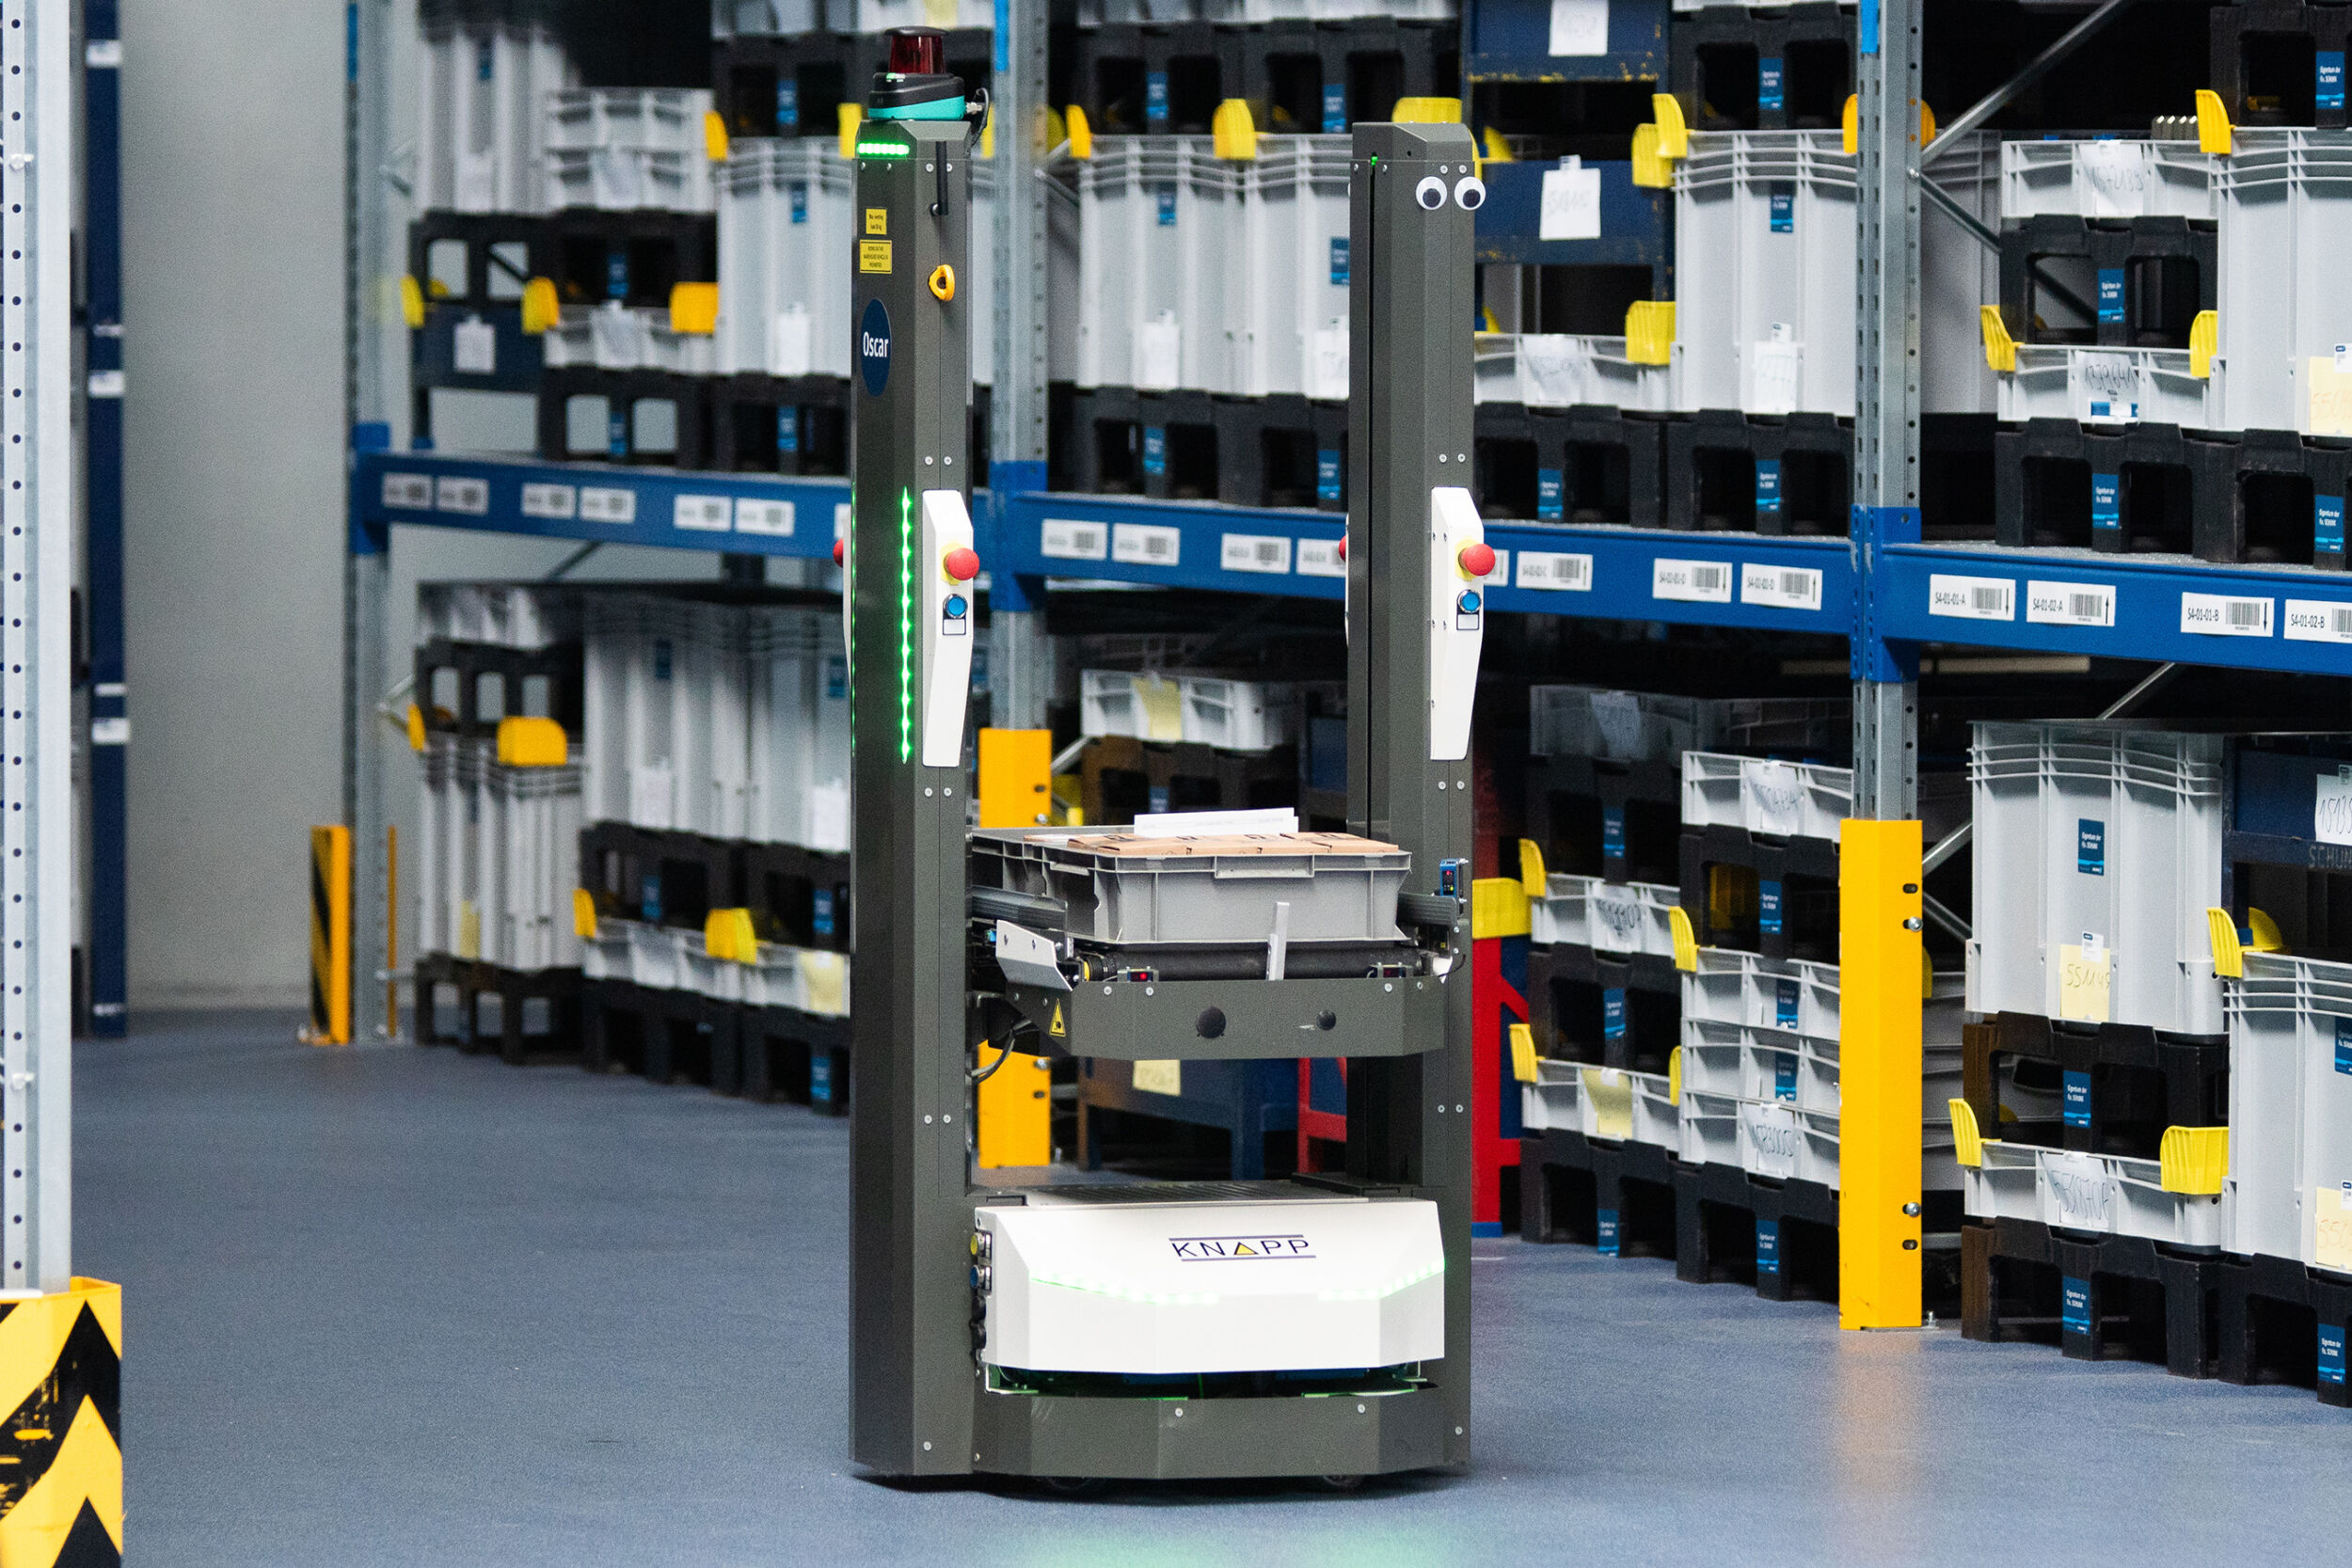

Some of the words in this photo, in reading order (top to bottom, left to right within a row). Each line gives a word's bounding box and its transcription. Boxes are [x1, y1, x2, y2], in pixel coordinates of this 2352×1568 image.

[863, 331, 889, 357] Oscar
[1934, 591, 1966, 606] S4-01-01-A
[2032, 597, 2063, 612] S4-01-02-A
[2187, 607, 2219, 622] S4-01-01-B
[2290, 613, 2325, 628] S4-01-02-B
[1171, 1239, 1310, 1258] KNAPP
